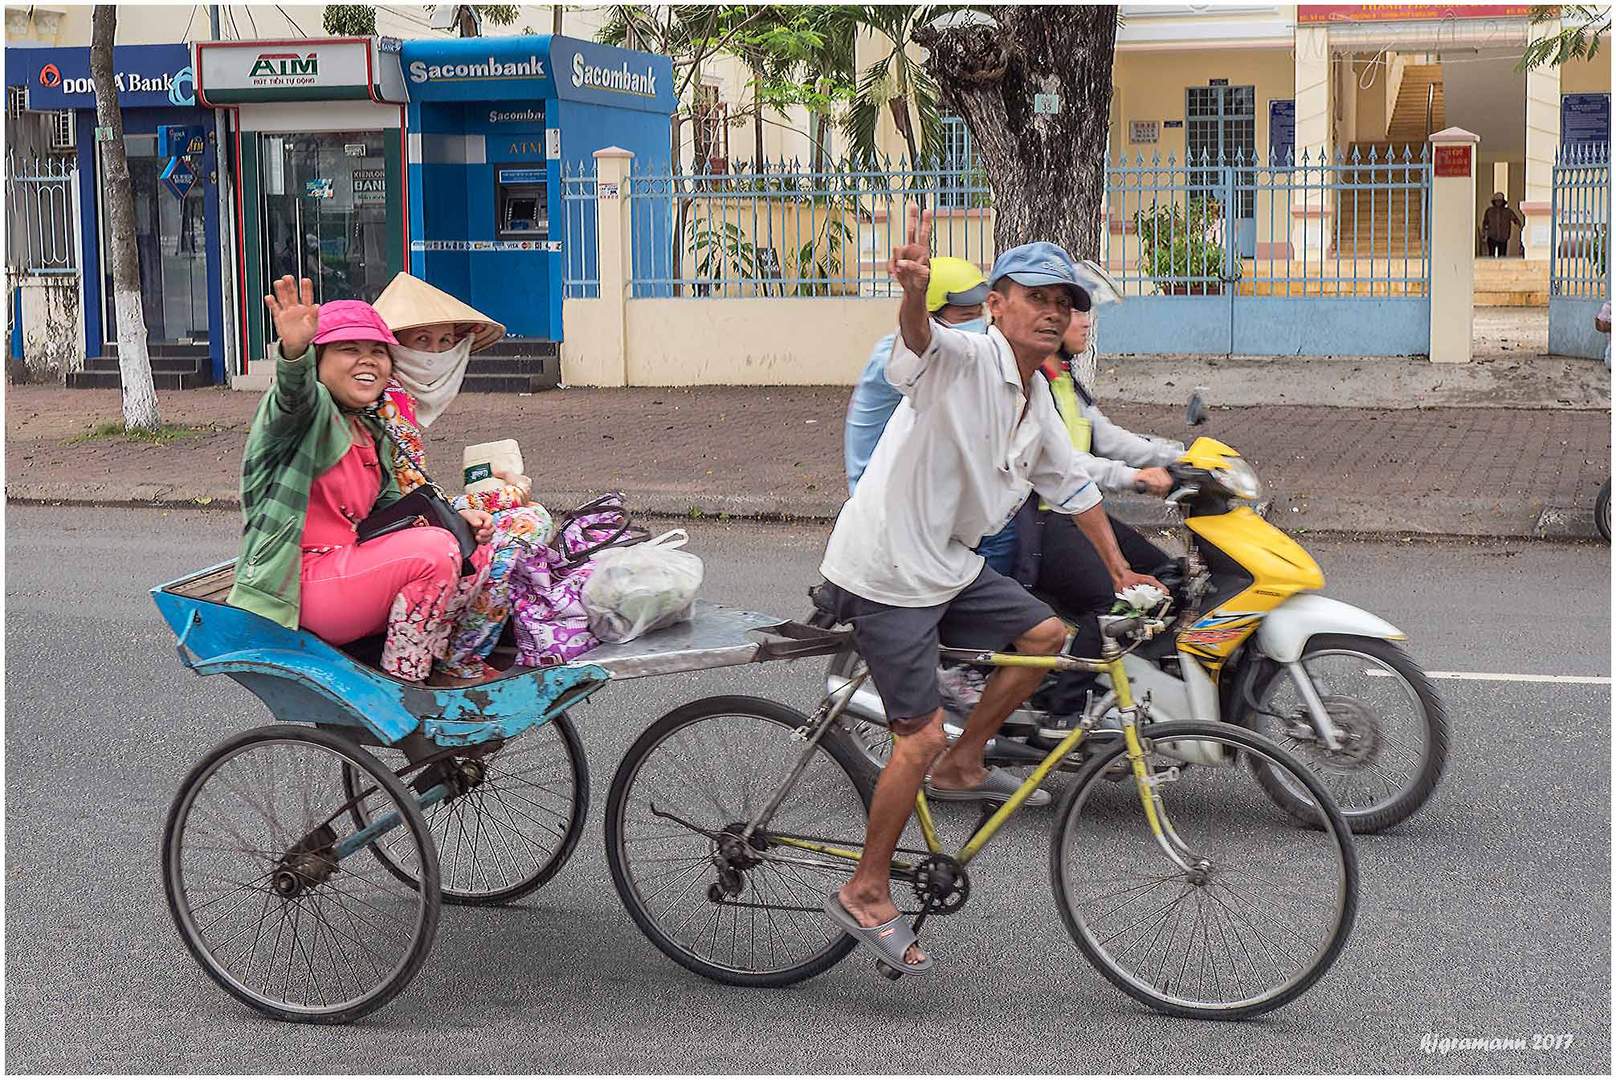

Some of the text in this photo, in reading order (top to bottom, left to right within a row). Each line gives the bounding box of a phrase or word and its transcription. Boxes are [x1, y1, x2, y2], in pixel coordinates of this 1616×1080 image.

[249, 53, 318, 77] ATM
[409, 56, 544, 84] Sacombank
[571, 52, 656, 95] Sacombank
[128, 73, 173, 91] Bank
[510, 143, 542, 154] ATM
